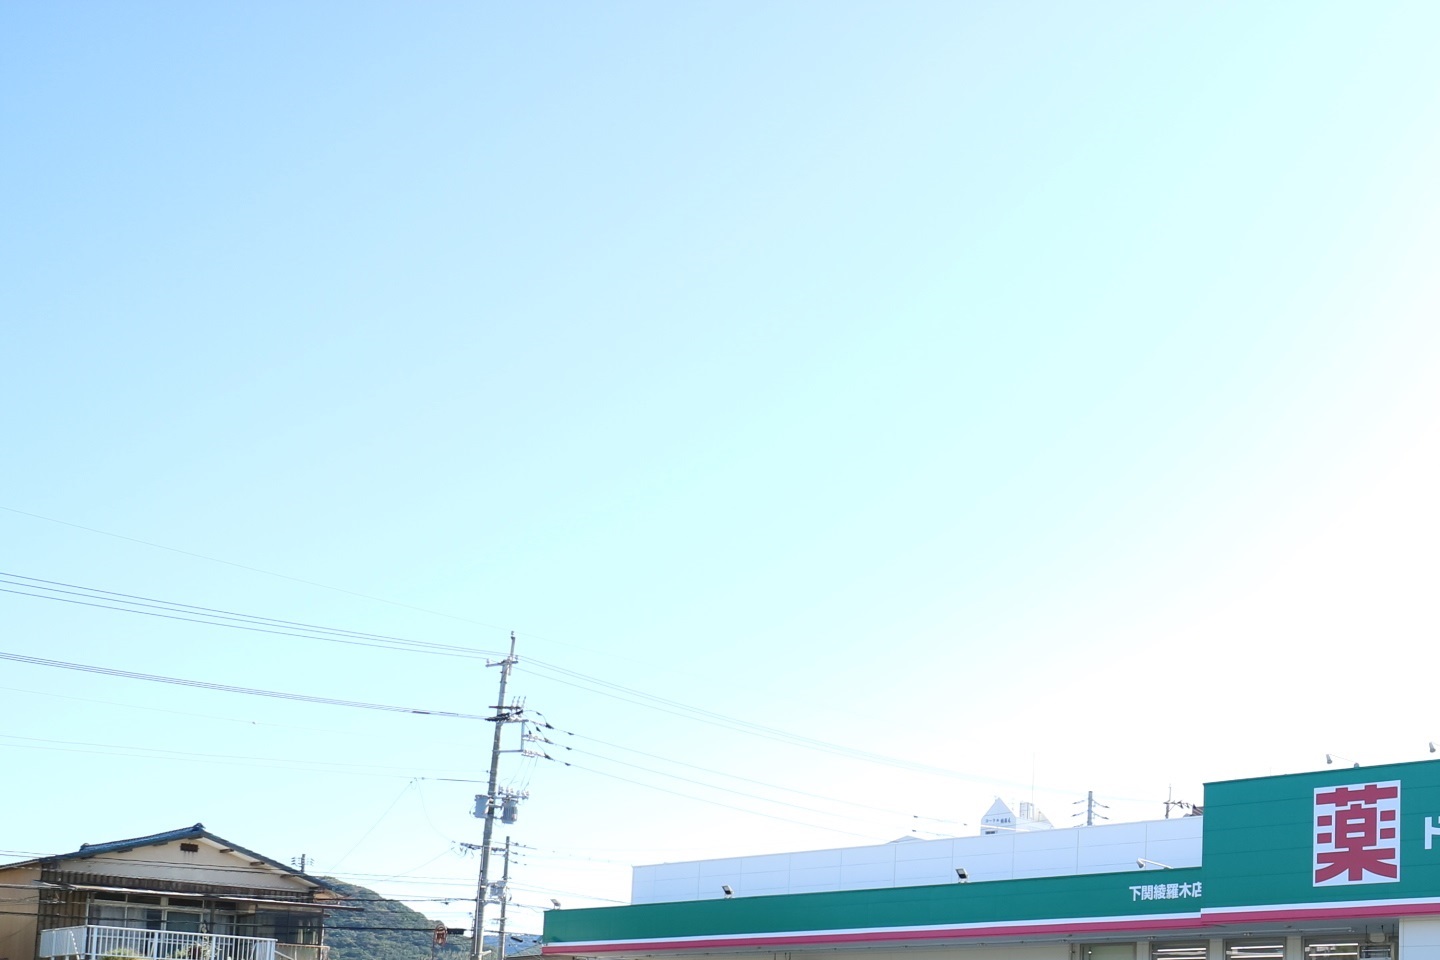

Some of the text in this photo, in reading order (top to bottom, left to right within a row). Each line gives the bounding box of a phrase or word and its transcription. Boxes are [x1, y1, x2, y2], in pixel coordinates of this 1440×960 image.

[1315, 784, 1398, 884] 薬
[1129, 881, 1202, 901] 下関綾羅木店
